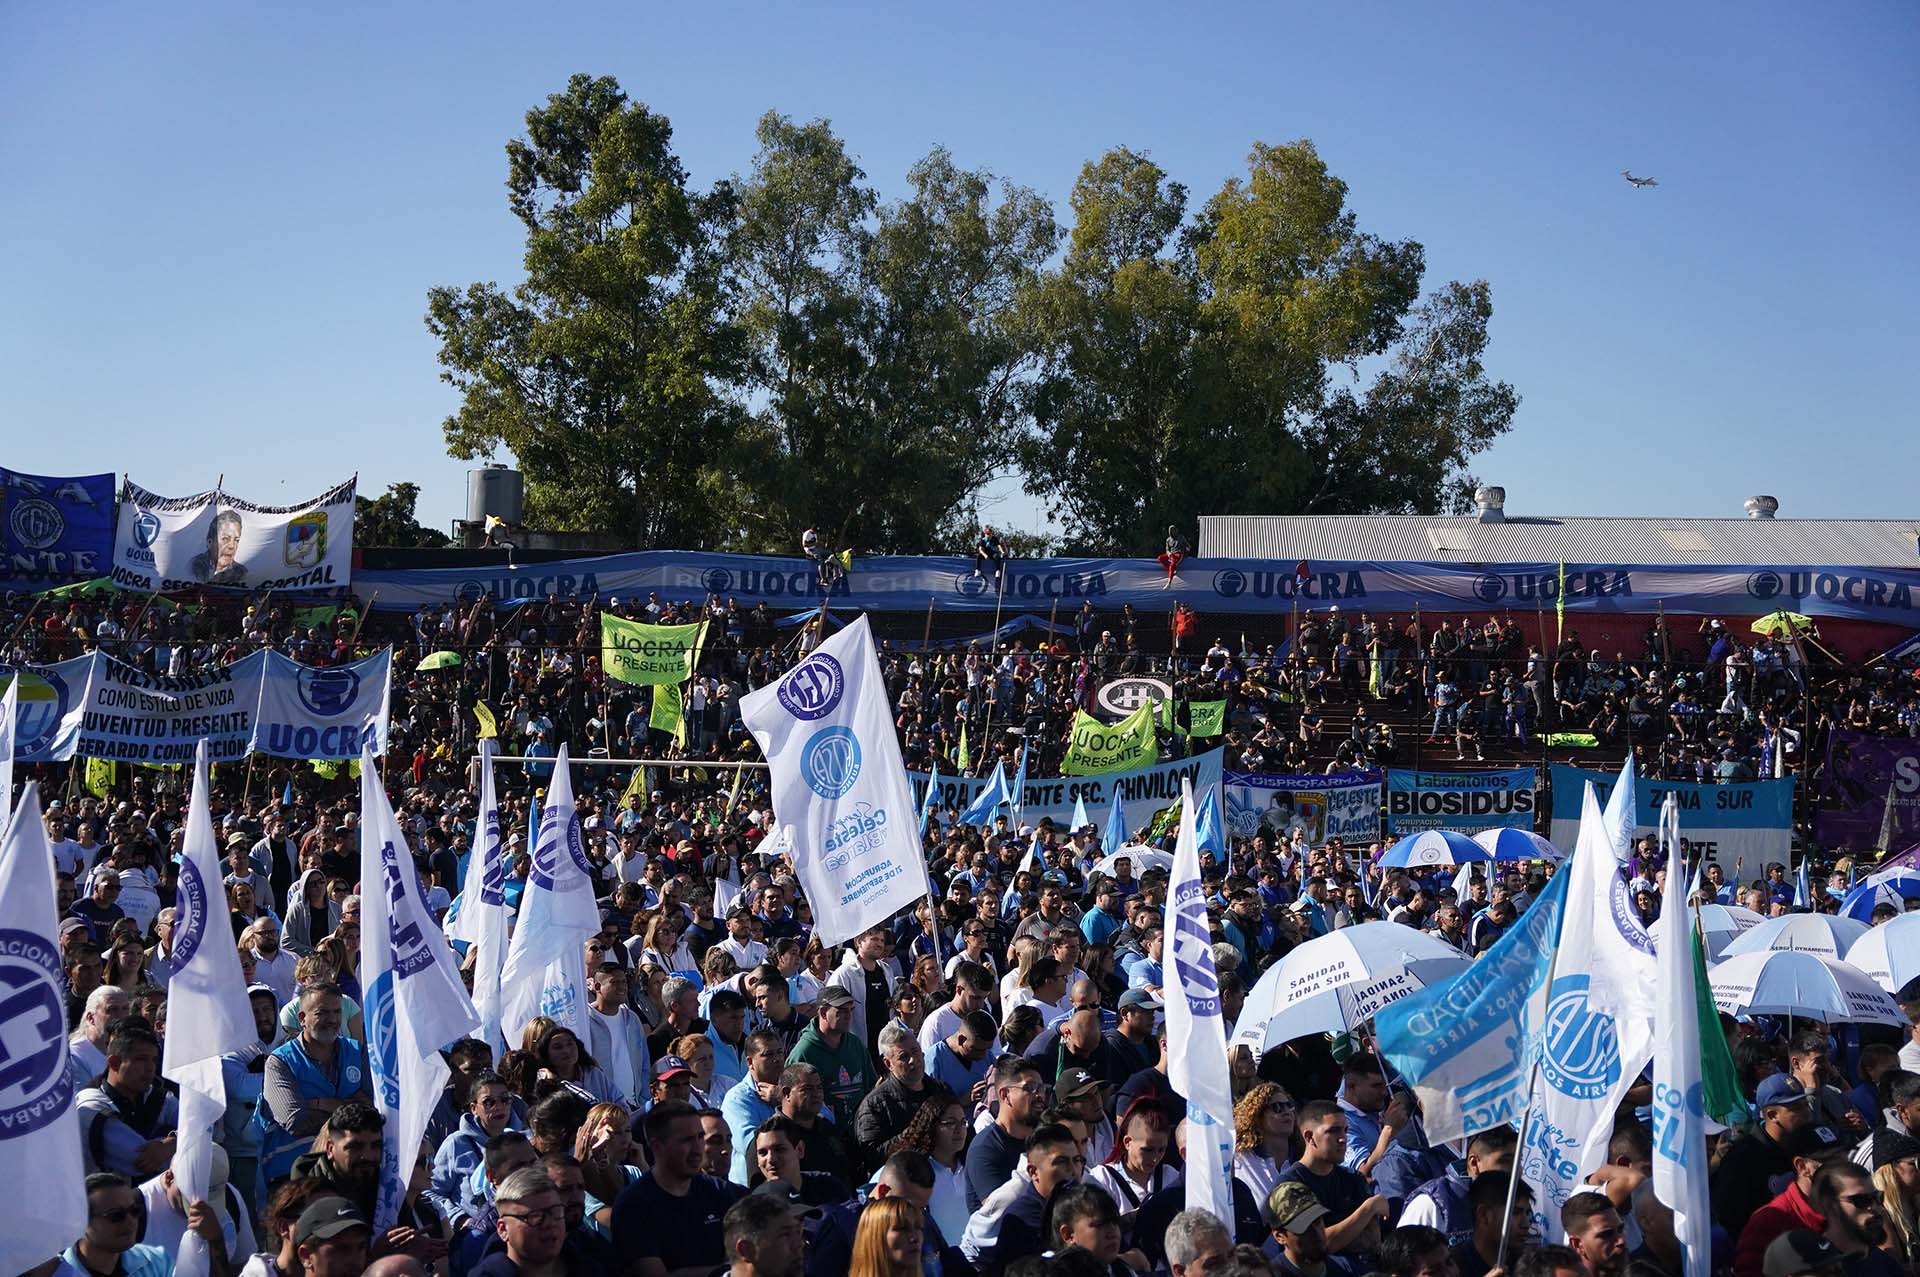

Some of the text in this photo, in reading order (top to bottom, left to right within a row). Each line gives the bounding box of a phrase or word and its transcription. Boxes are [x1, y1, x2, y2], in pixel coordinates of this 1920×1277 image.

[254, 564, 337, 592] CAPITAL
[490, 572, 600, 600] UOCRA
[1253, 571, 1367, 600] UOCRA
[1513, 571, 1632, 601] UOCRA
[1789, 571, 1912, 610] UOCRA
[613, 632, 686, 658] UOCRA
[613, 655, 686, 673] PRESENTE
[97, 688, 235, 713] COMO ESTILO DE VIDA
[81, 711, 249, 738] JUVENTUD PRESENTE
[77, 736, 150, 760] GERARDO
[1076, 727, 1140, 752] UOCRA
[1071, 744, 1142, 768] PRESENTE
[1072, 782, 1106, 805] SEC.
[1415, 774, 1509, 788] Laboratorios
[1390, 789, 1533, 816] BIOSIDUS
[1716, 790, 1754, 810] SUR
[181, 871, 201, 936] GENERAL
[1287, 971, 1351, 1003] ZONA SUR
[1289, 960, 1346, 990] SANIDAD
[1572, 1082, 1608, 1097] AIRE
[0, 1094, 65, 1129] TRABA
